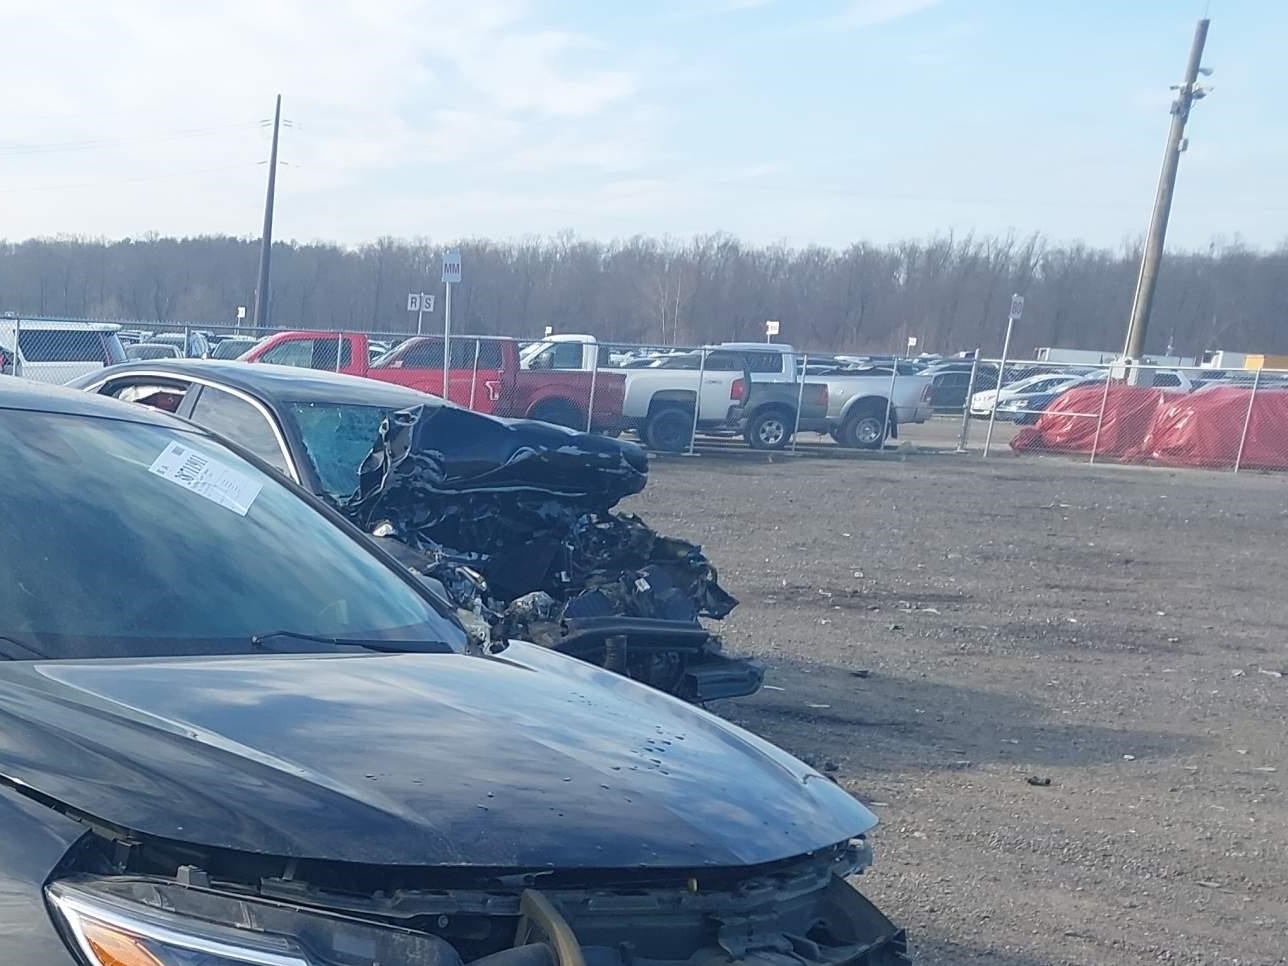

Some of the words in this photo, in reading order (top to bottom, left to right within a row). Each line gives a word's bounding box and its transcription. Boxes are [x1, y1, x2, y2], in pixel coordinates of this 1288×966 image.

[444, 263, 460, 274] MM
[410, 296, 418, 309] R
[424, 297, 432, 310] S
